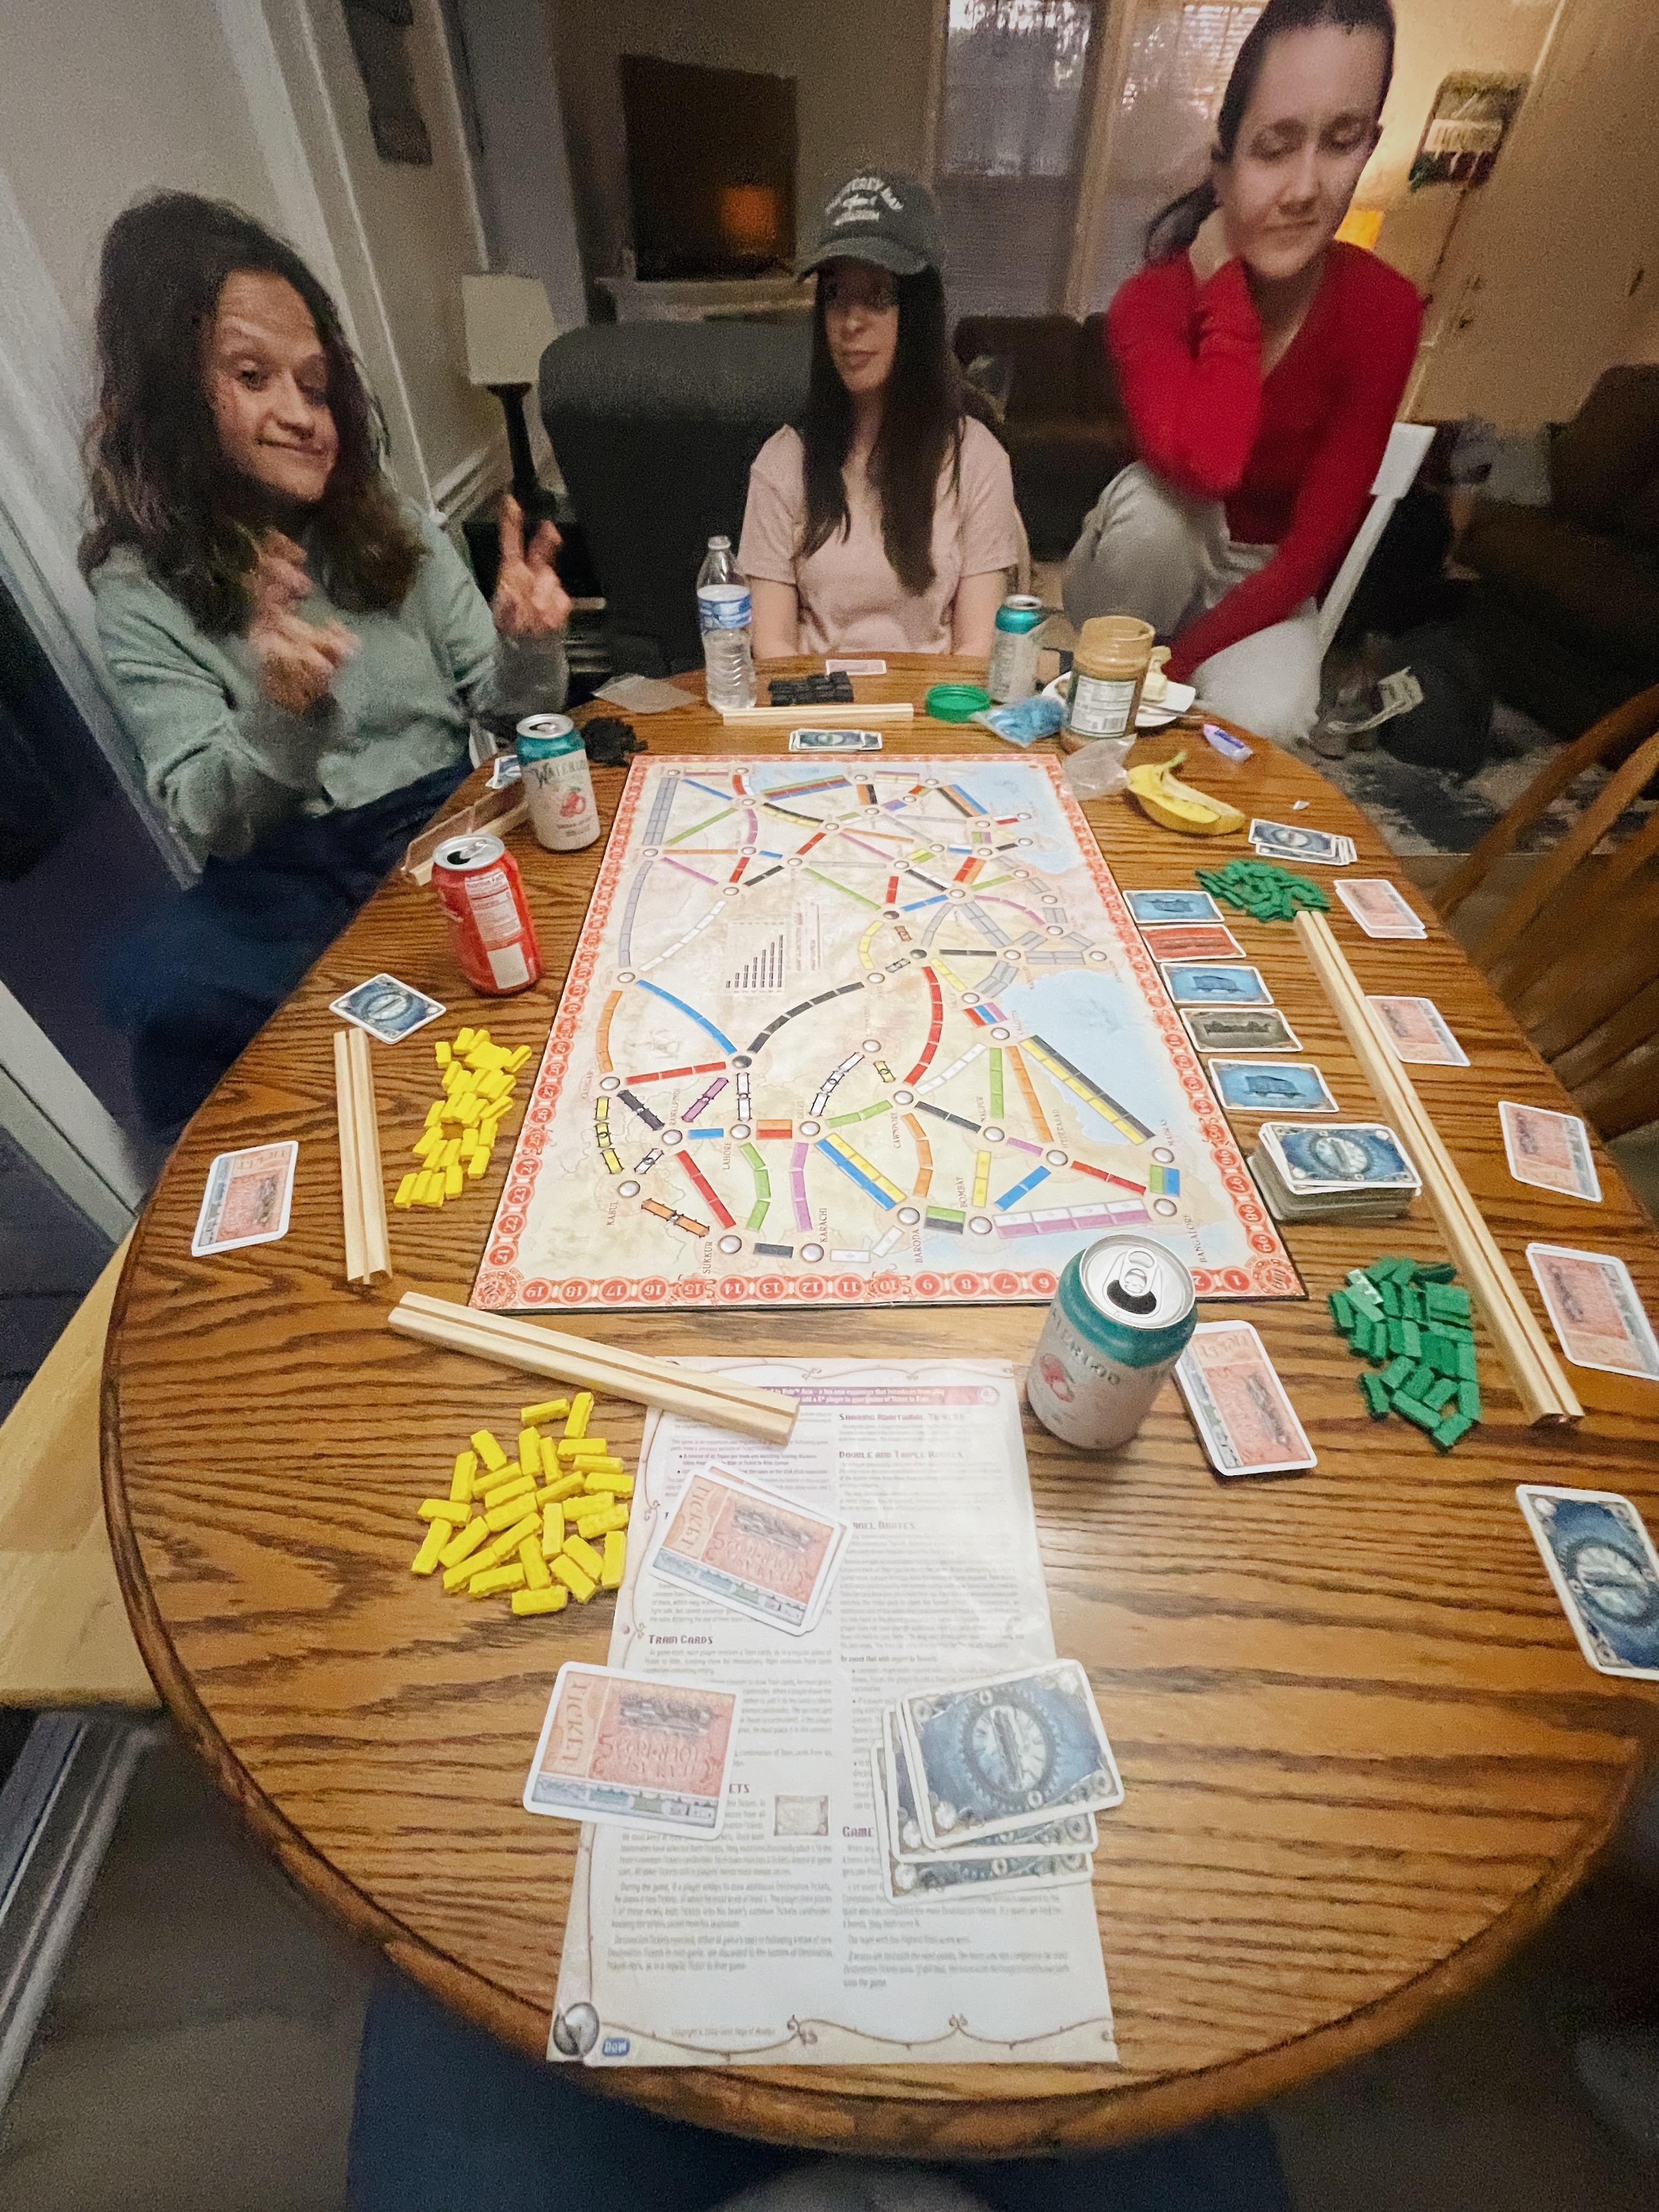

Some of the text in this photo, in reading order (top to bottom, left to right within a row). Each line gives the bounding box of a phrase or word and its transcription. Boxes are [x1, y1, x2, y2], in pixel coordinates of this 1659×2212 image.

[723, 1142, 732, 1170] LAHORE
[521, 1160, 535, 1174] 24
[512, 1187, 526, 1203] 23
[956, 1177, 968, 1209] BOMBAY
[606, 1200, 618, 1226] KABUL
[504, 1216, 518, 1231] 22
[819, 1207, 828, 1243] KARACHI
[912, 1228, 923, 1263] BARODA
[1182, 1214, 1208, 1263] BANGALORE
[495, 1249, 510, 1263] 21
[702, 1241, 713, 1274] SUKKUR
[880, 1280, 898, 1291] 10
[961, 1279, 973, 1289] 8
[1001, 1278, 1011, 1289] 7
[1272, 1268, 1289, 1290] 100
[526, 1286, 543, 1297] 19
[566, 1285, 583, 1296] 18
[606, 1284, 622, 1295] 17
[645, 1284, 662, 1295] 16
[685, 1284, 703, 1295] 15
[725, 1283, 741, 1295] 14
[763, 1283, 780, 1294] 13
[802, 1282, 820, 1294] 12
[842, 1282, 858, 1293] 11
[681, 1485, 710, 1547] TICKET
[562, 1680, 587, 1762] TICKET
